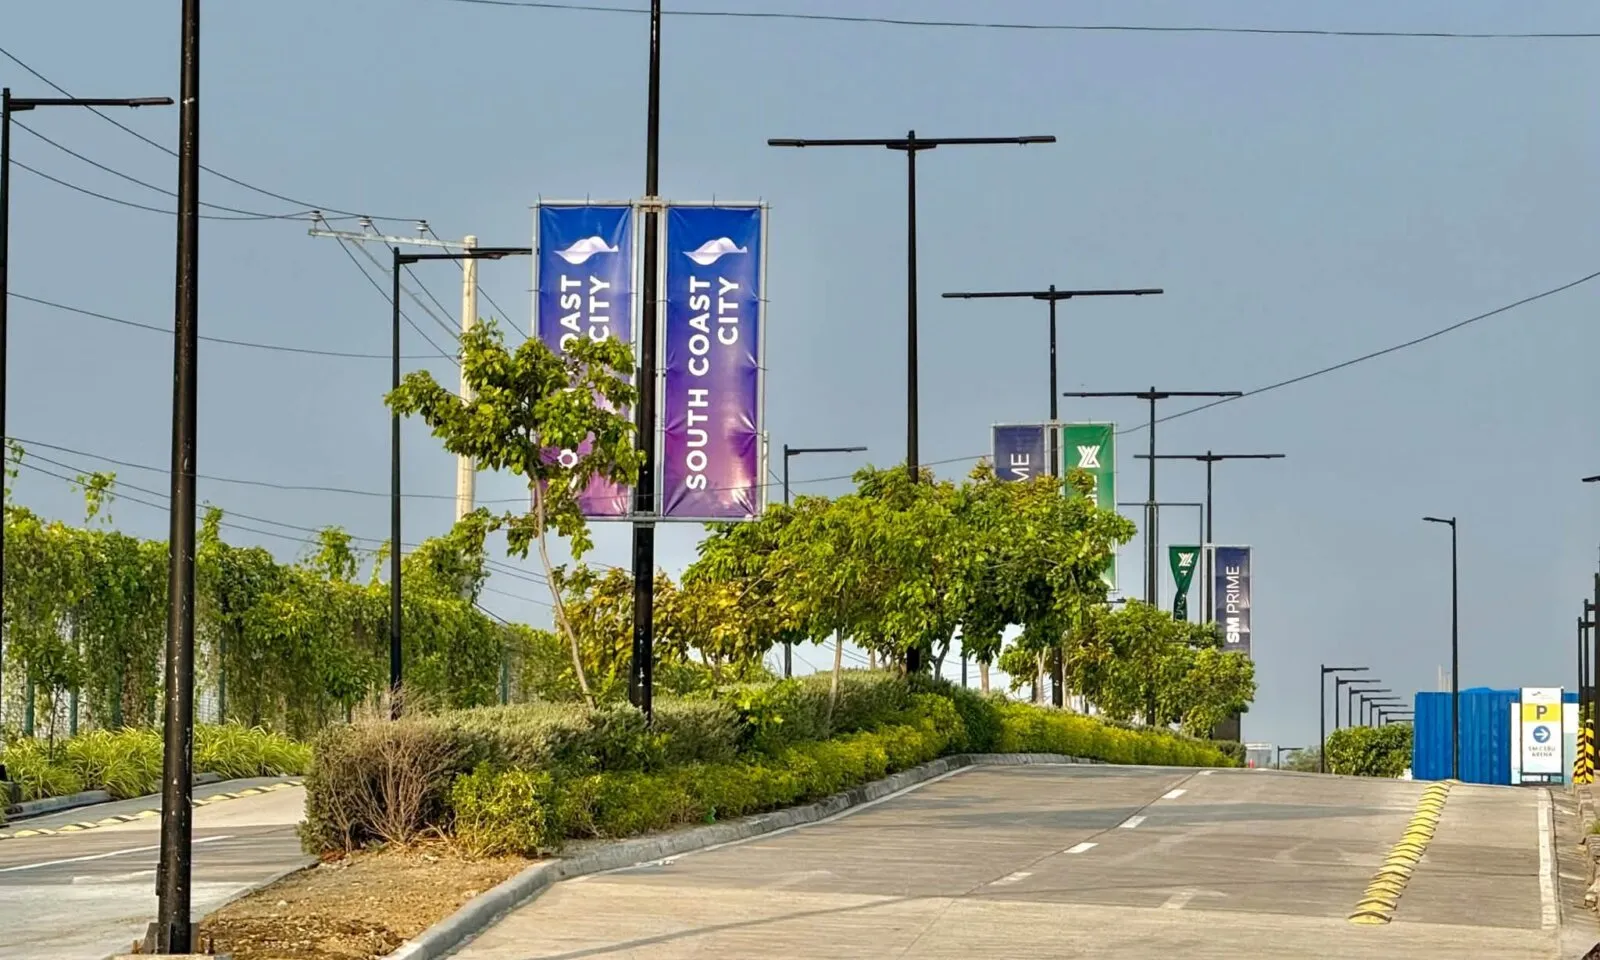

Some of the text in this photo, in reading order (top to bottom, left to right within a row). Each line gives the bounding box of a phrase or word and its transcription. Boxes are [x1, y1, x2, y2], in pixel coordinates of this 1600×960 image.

[559, 274, 582, 370] OAST
[588, 275, 611, 344] CITY
[717, 276, 740, 346] CITY
[686, 275, 711, 491] SOUTH COAST
[1226, 565, 1240, 644] SM PRIME
[1536, 705, 1548, 720] P
